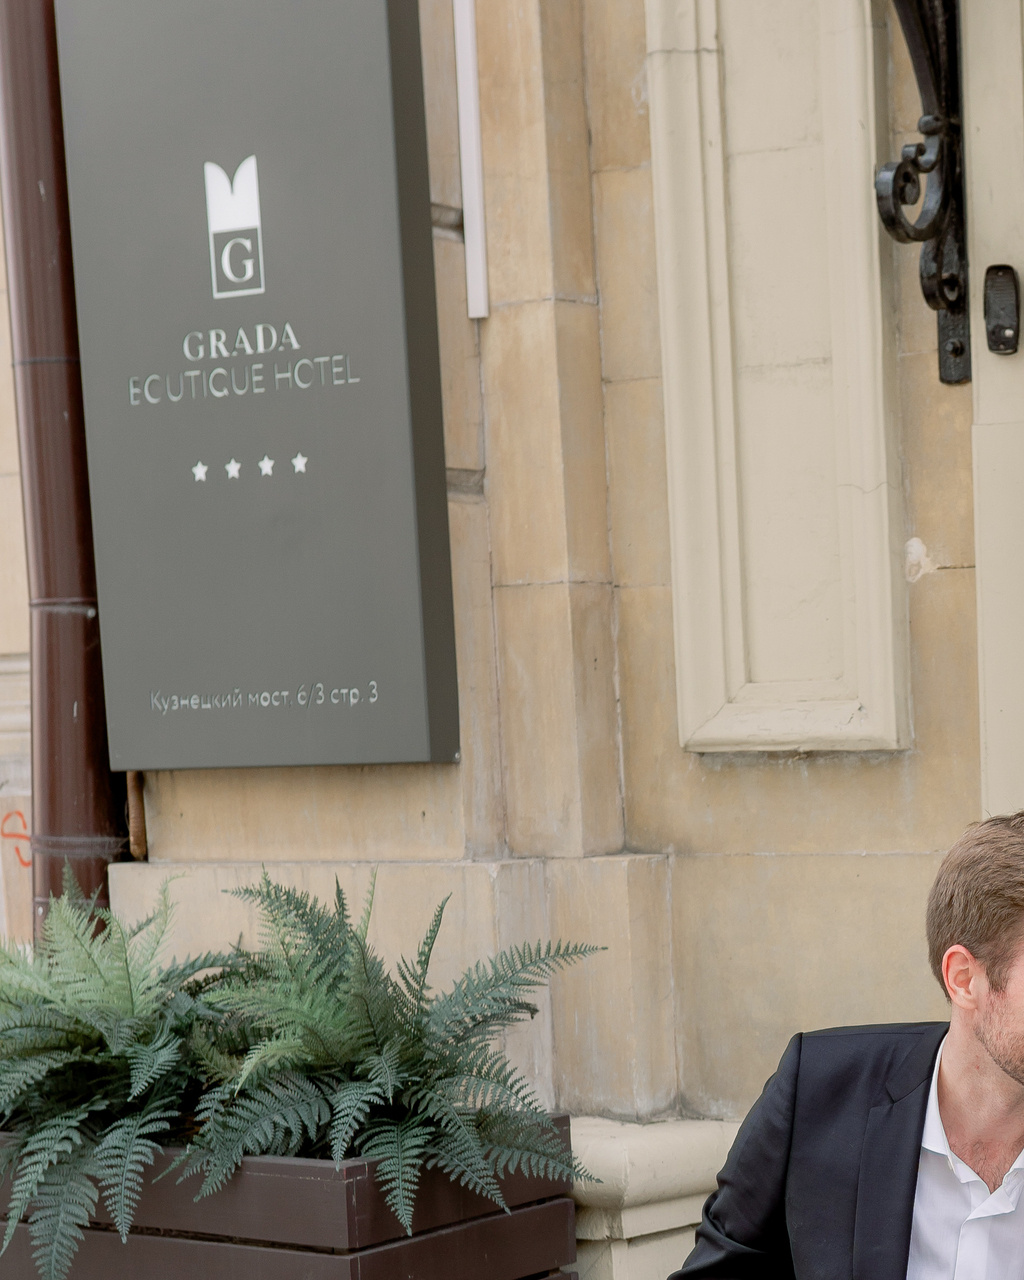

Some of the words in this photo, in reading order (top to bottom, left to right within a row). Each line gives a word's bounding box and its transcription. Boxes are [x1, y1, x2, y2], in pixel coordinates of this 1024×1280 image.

[221, 237, 255, 283] G
[182, 321, 301, 361] GRADA
[274, 353, 361, 391] HOTEL
[150, 688, 242, 716] Кузнецкий
[297, 682, 325, 709] 6/3
[330, 687, 364, 707] стр.
[368, 680, 379, 704] 3
